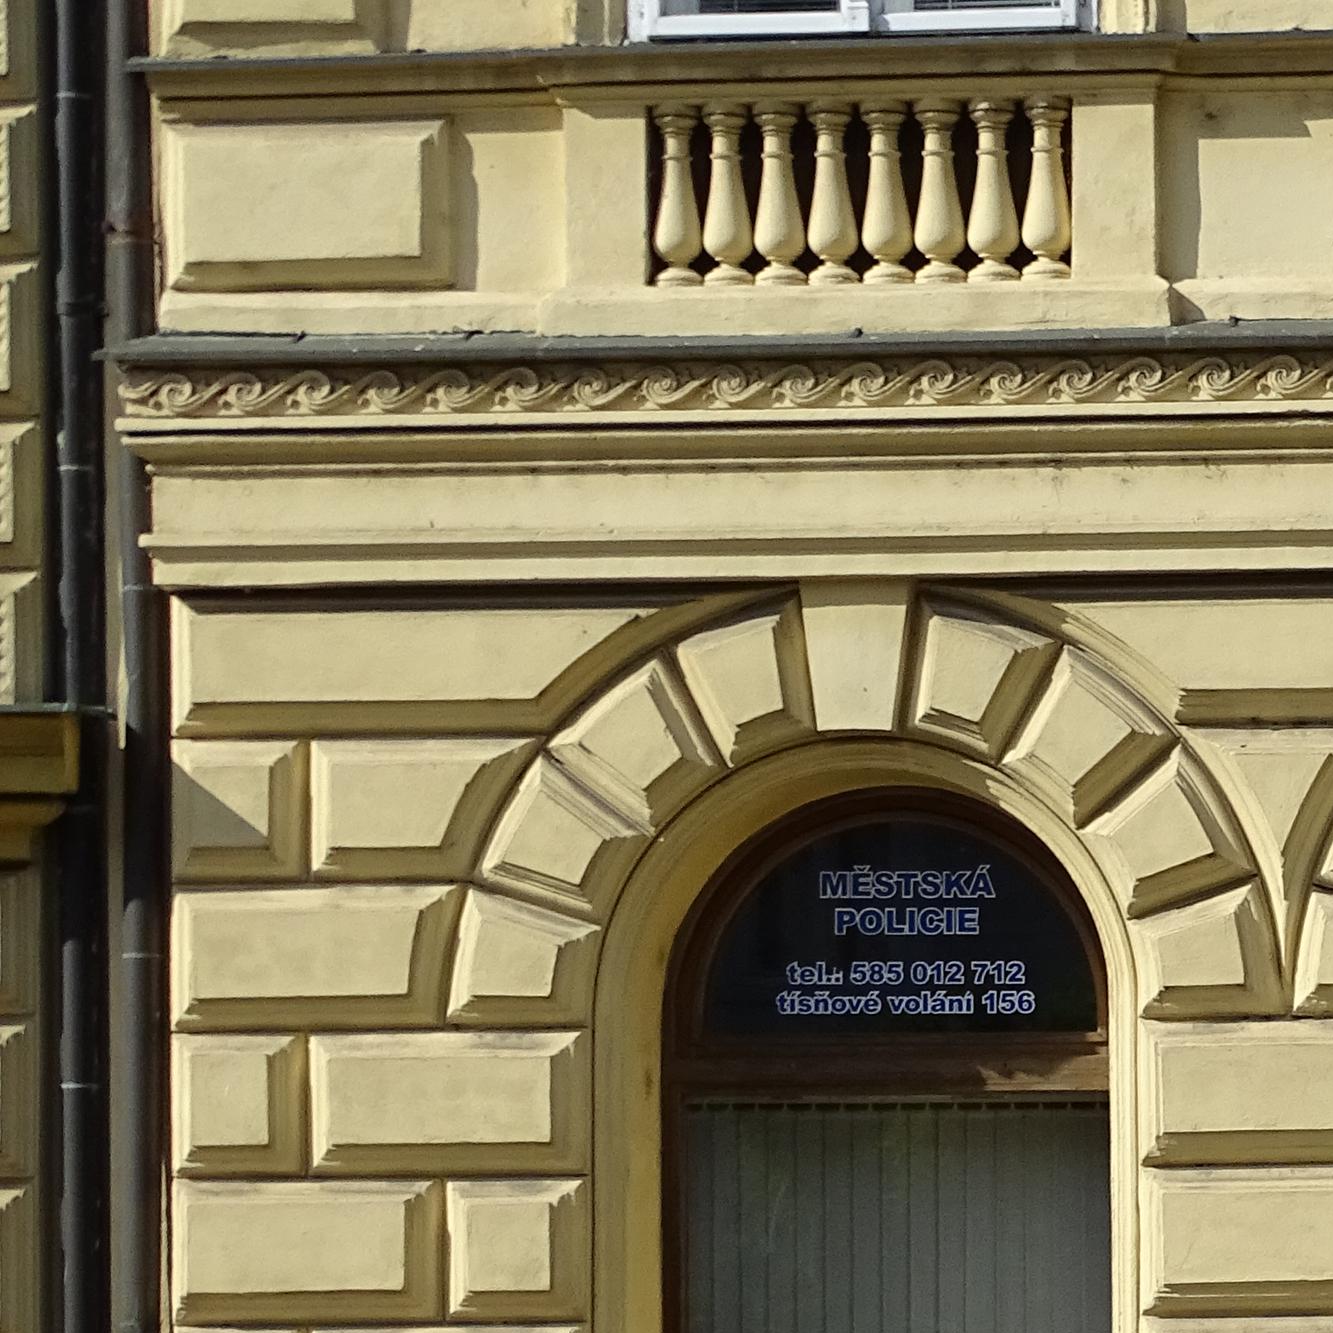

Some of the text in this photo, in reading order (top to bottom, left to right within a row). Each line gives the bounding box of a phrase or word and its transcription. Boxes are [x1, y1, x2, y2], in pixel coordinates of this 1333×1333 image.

[819, 865, 996, 899] MĚSTSKÁ
[834, 907, 980, 936] POLICIE
[850, 961, 904, 985] 585
[910, 961, 965, 985] 012
[971, 961, 1026, 985] 712
[776, 990, 1036, 1015] tísňové volání 156
